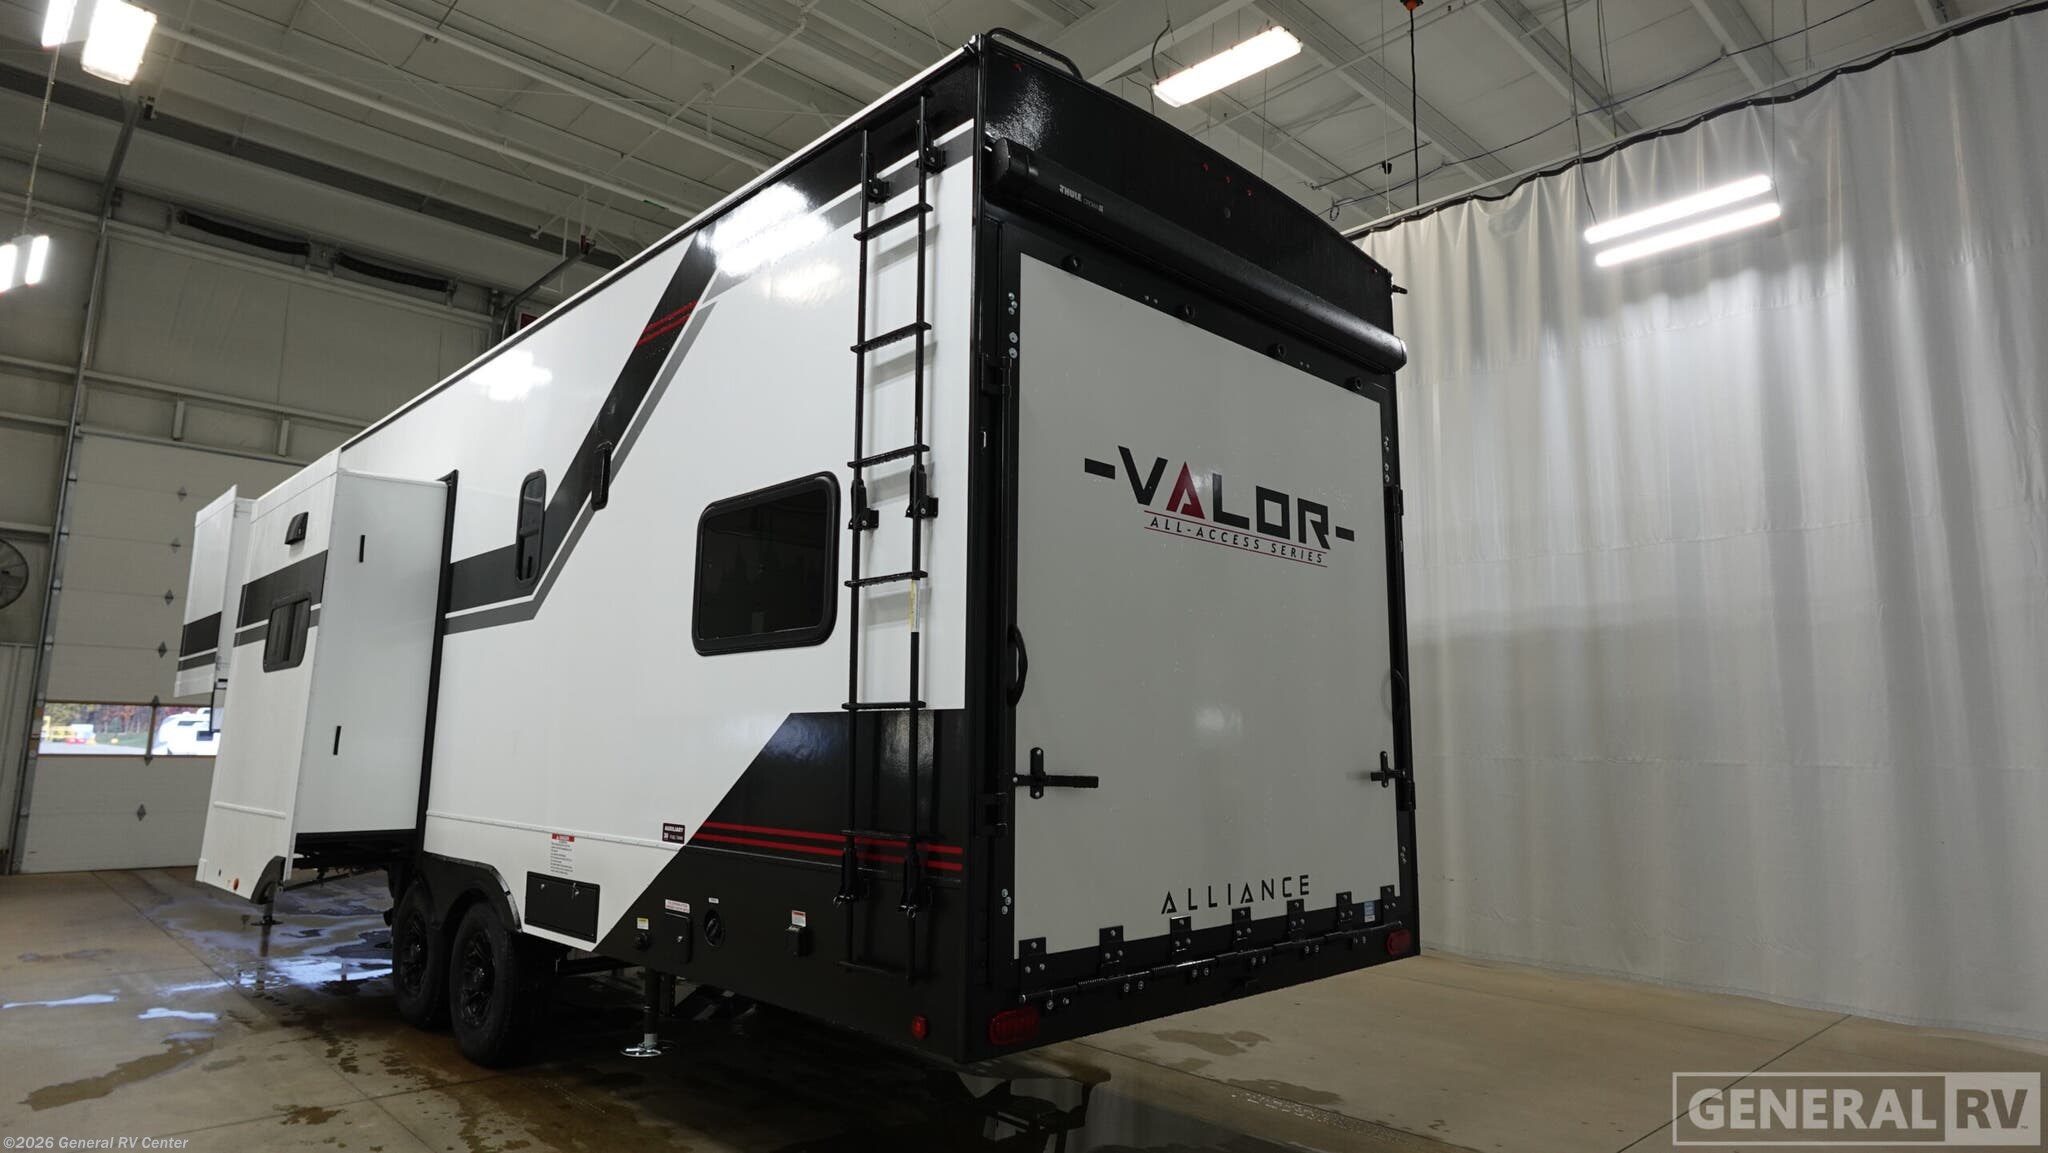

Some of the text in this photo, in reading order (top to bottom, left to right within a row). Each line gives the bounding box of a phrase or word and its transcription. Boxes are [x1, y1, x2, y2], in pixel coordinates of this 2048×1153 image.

[1060, 184, 1082, 202] THULE
[1150, 516, 1323, 564] ALL-ACCESS SERIES
[1161, 874, 1309, 915] ALLIANCE
